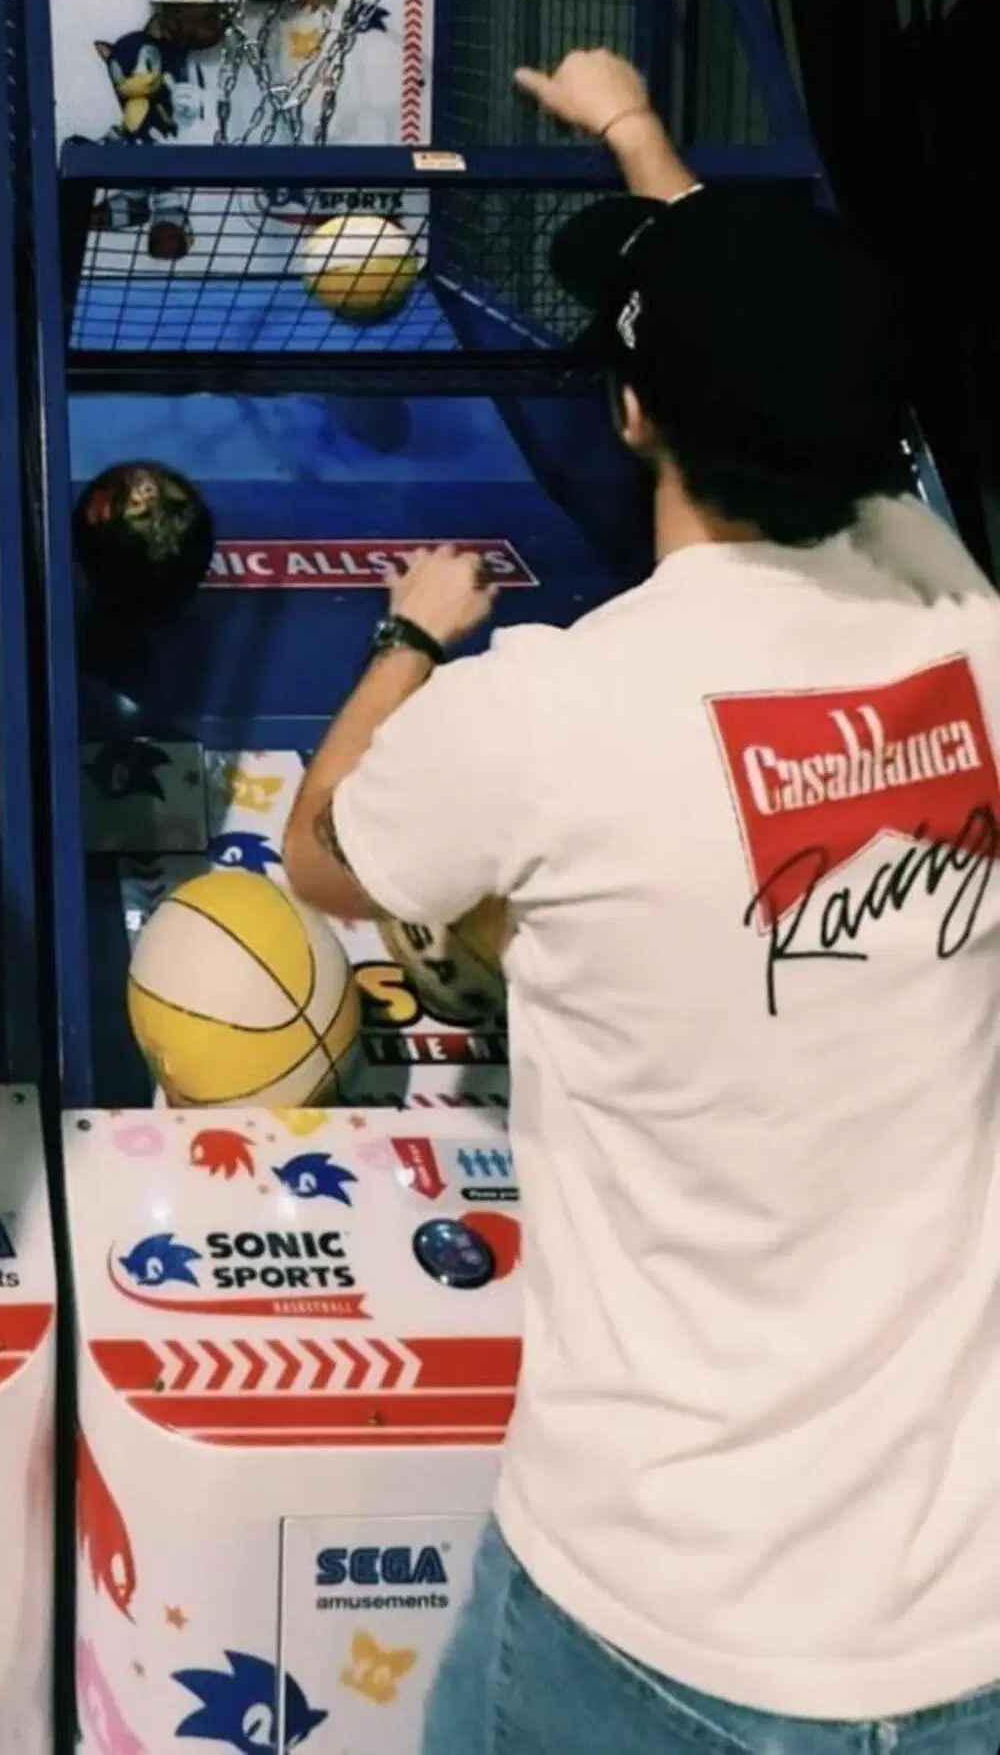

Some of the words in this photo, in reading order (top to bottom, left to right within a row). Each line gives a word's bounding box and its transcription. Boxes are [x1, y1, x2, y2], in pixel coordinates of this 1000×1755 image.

[318, 192, 403, 210] SPORTS
[207, 551, 275, 576] NIC
[286, 550, 516, 576] ALLSS
[743, 704, 981, 815] Casablanca
[743, 801, 998, 1016] Racing
[206, 1231, 347, 1259] SONIC
[212, 1265, 356, 1289] SPORTS
[315, 1545, 448, 1586] SEGA
[315, 1592, 449, 1610] amusements
